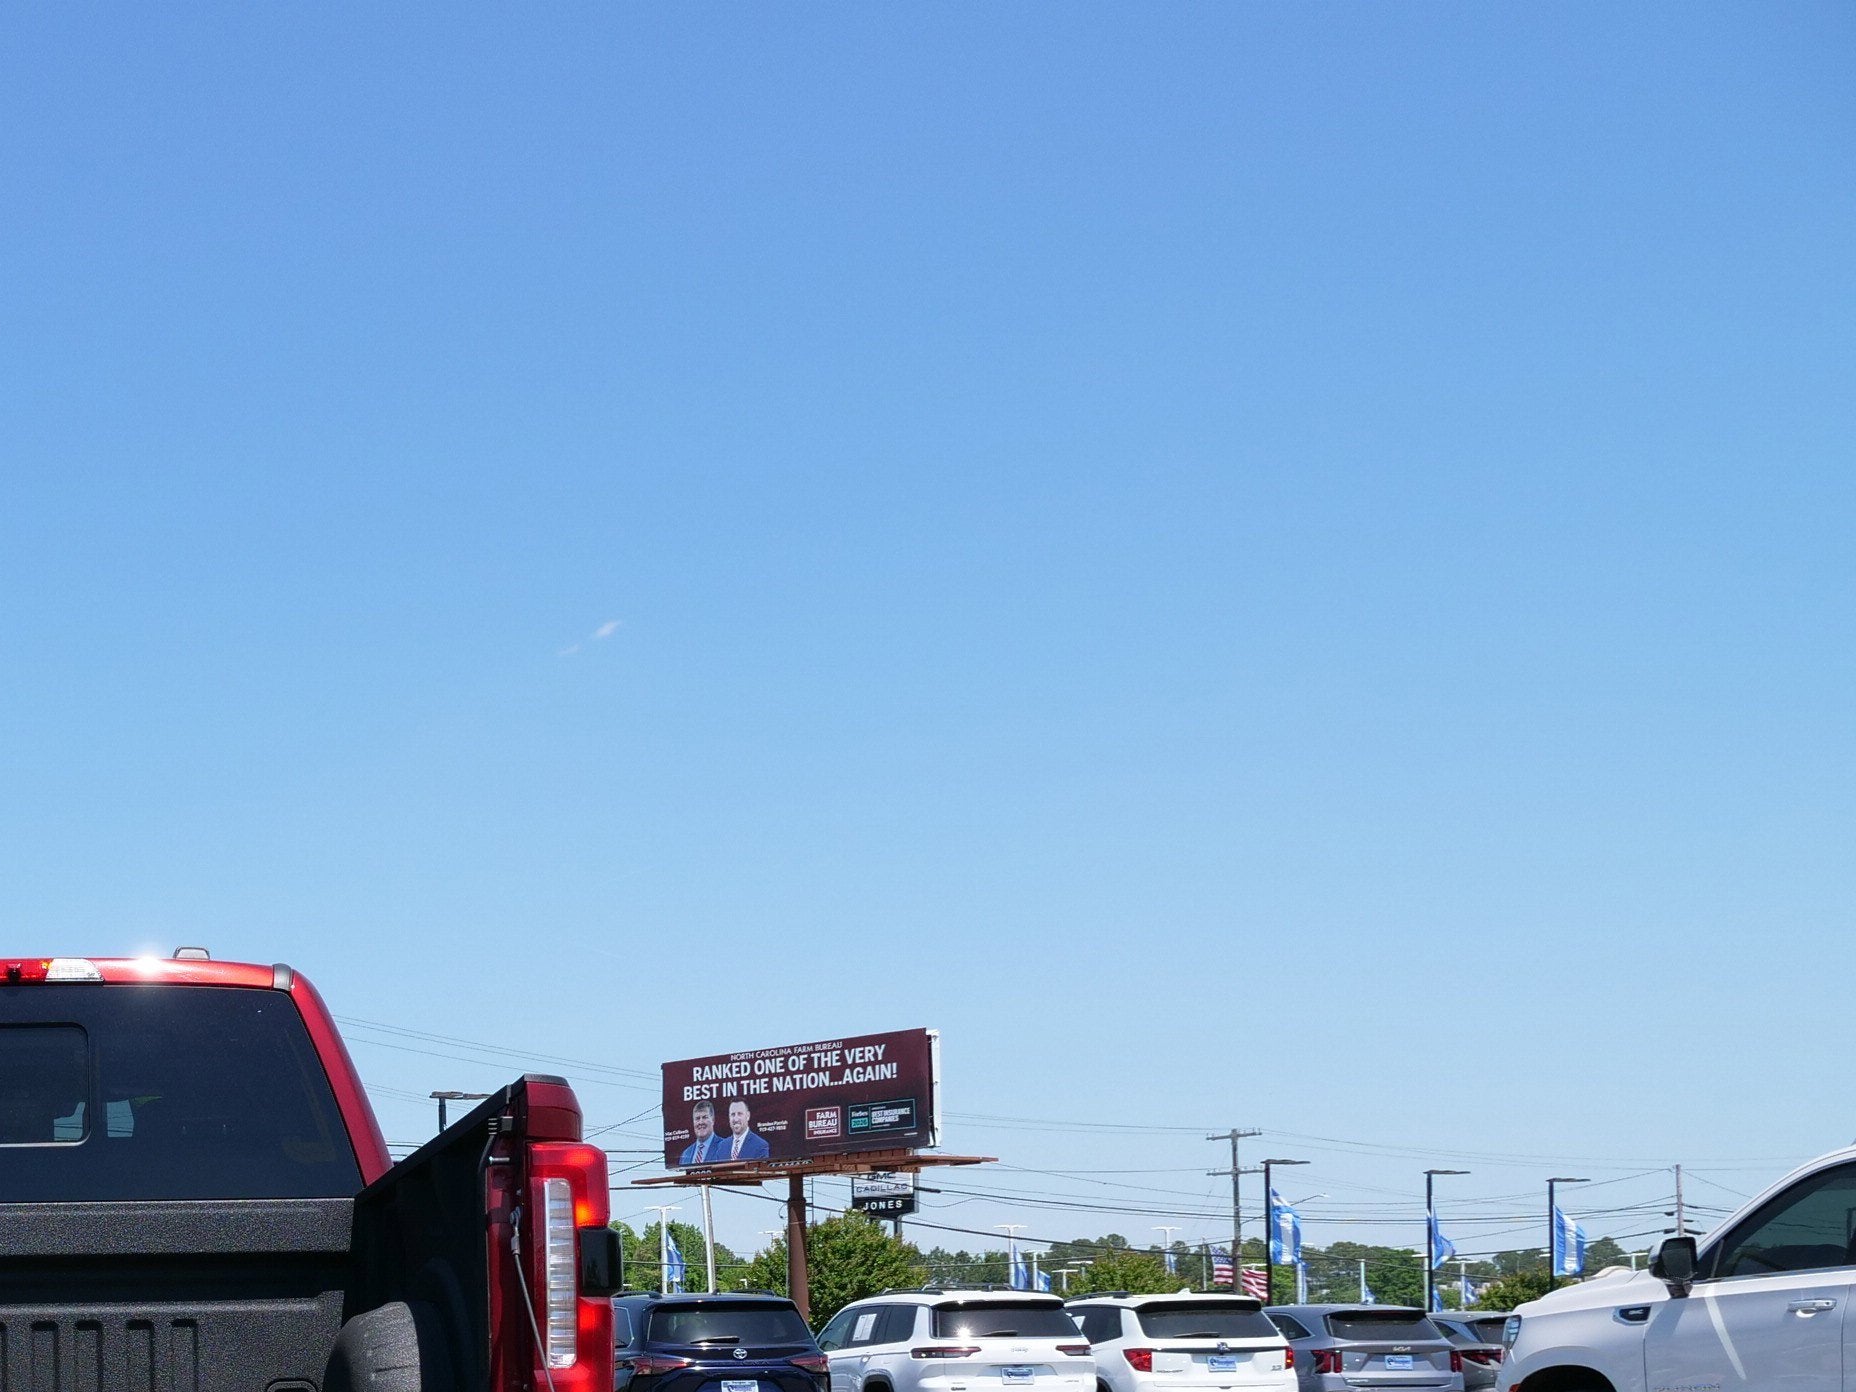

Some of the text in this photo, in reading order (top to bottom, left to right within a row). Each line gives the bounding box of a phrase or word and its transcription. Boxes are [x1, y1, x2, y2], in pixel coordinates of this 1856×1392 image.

[731, 1041, 843, 1061] NORTH CAROLINA FARM BUREAU
[693, 1044, 886, 1082] RANKED ONE OF THE VERY
[683, 1062, 898, 1102] BEST IN THE NATION...AGAIN!
[816, 1111, 837, 1120] FARM
[808, 1118, 837, 1128] BUREAU
[856, 1183, 908, 1194] CADILLAC
[862, 1200, 903, 1211] JONES
